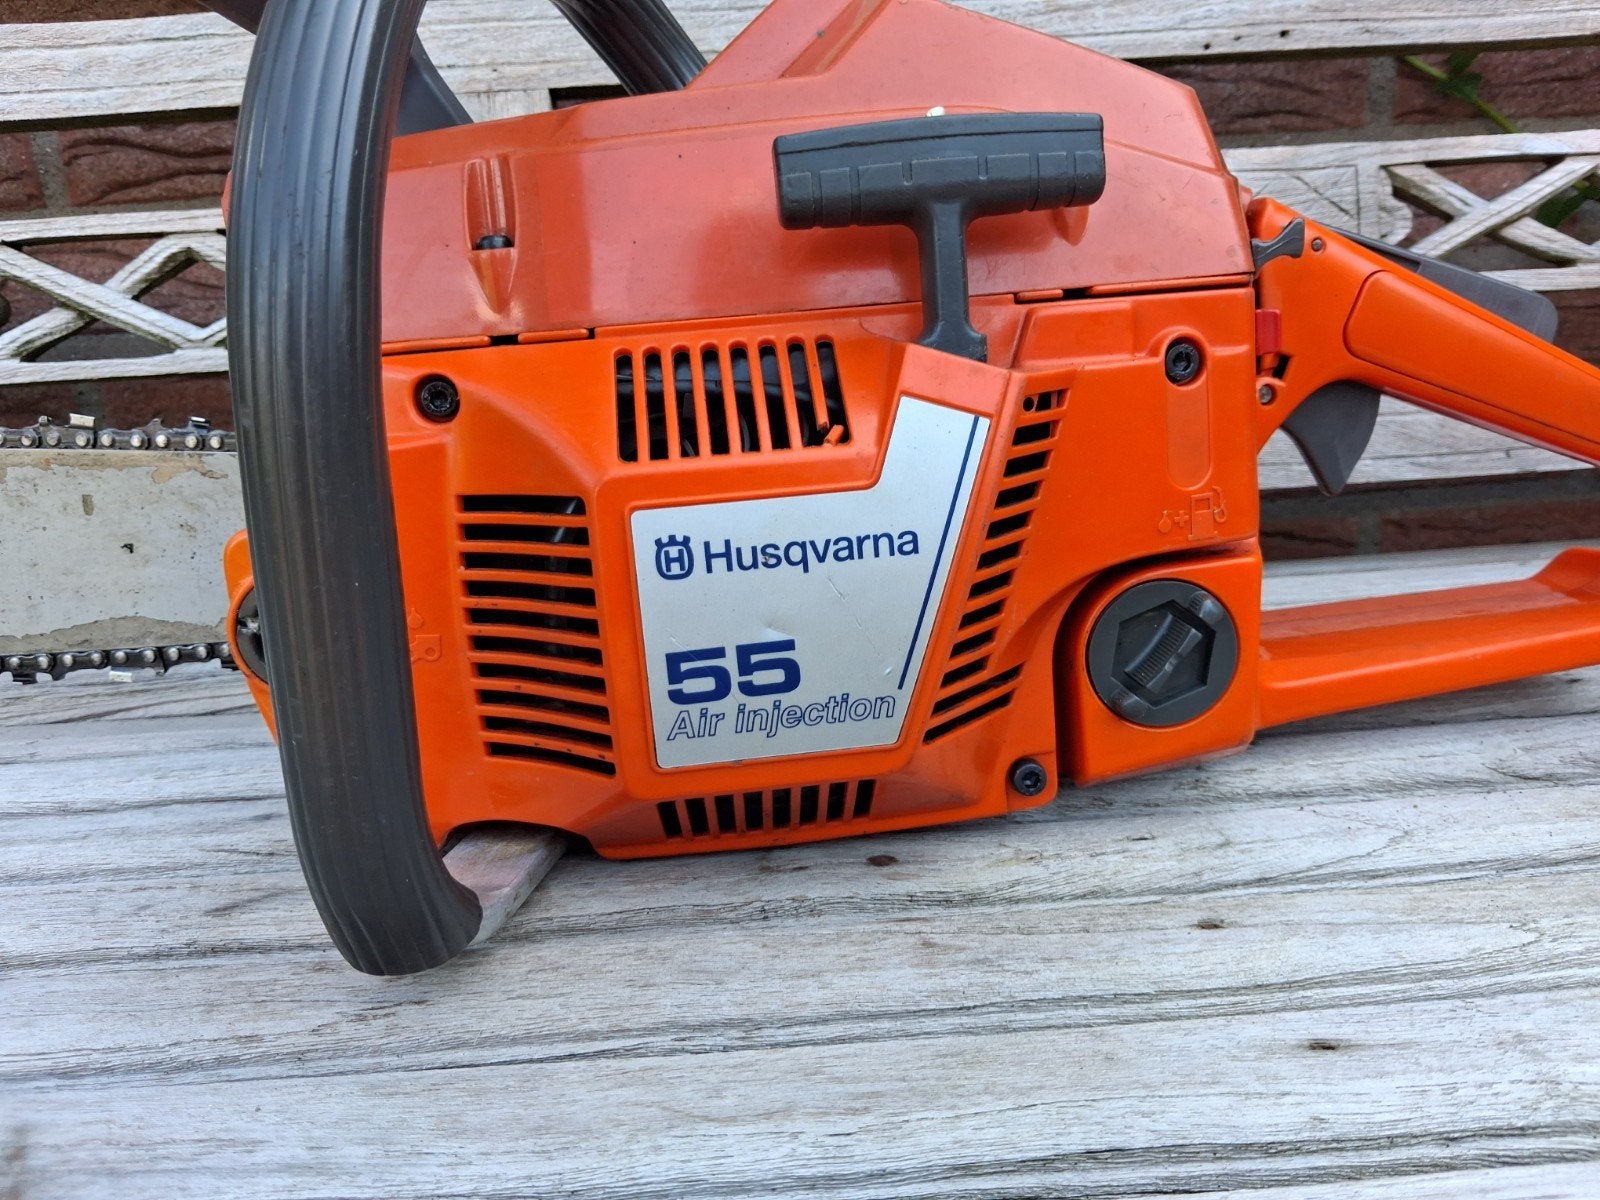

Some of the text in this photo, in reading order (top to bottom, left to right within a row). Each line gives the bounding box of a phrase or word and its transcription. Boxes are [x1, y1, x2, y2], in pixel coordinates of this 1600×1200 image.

[703, 530, 920, 574] Husqvarna
[665, 638, 801, 706] 55
[666, 693, 897, 742] Air injection
